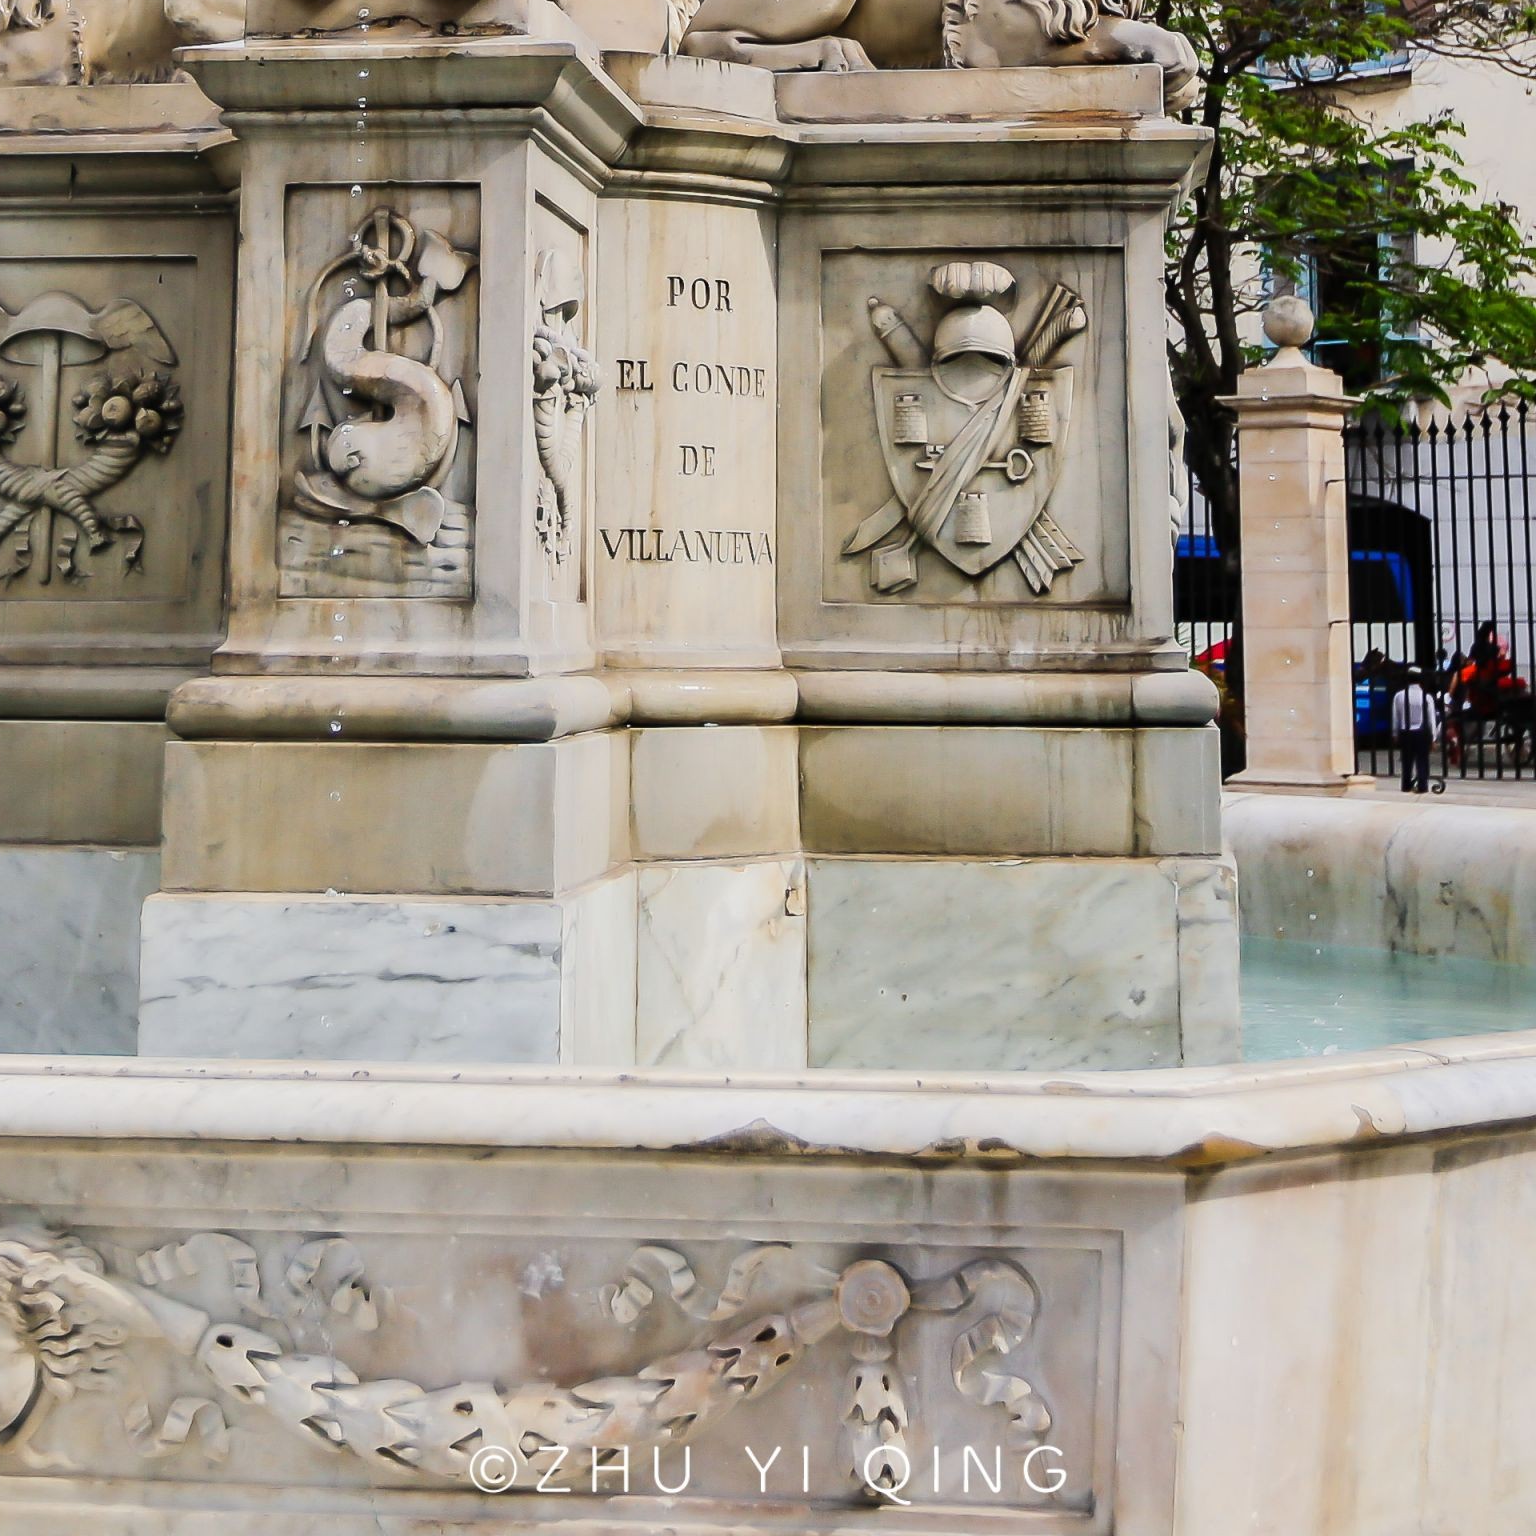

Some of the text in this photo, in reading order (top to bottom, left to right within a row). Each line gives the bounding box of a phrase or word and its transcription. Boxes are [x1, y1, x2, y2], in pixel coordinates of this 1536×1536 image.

[666, 275, 733, 313] POR
[616, 359, 766, 398] EL CONDE
[678, 445, 715, 477] DE
[599, 528, 773, 565] VILLANUEVA
